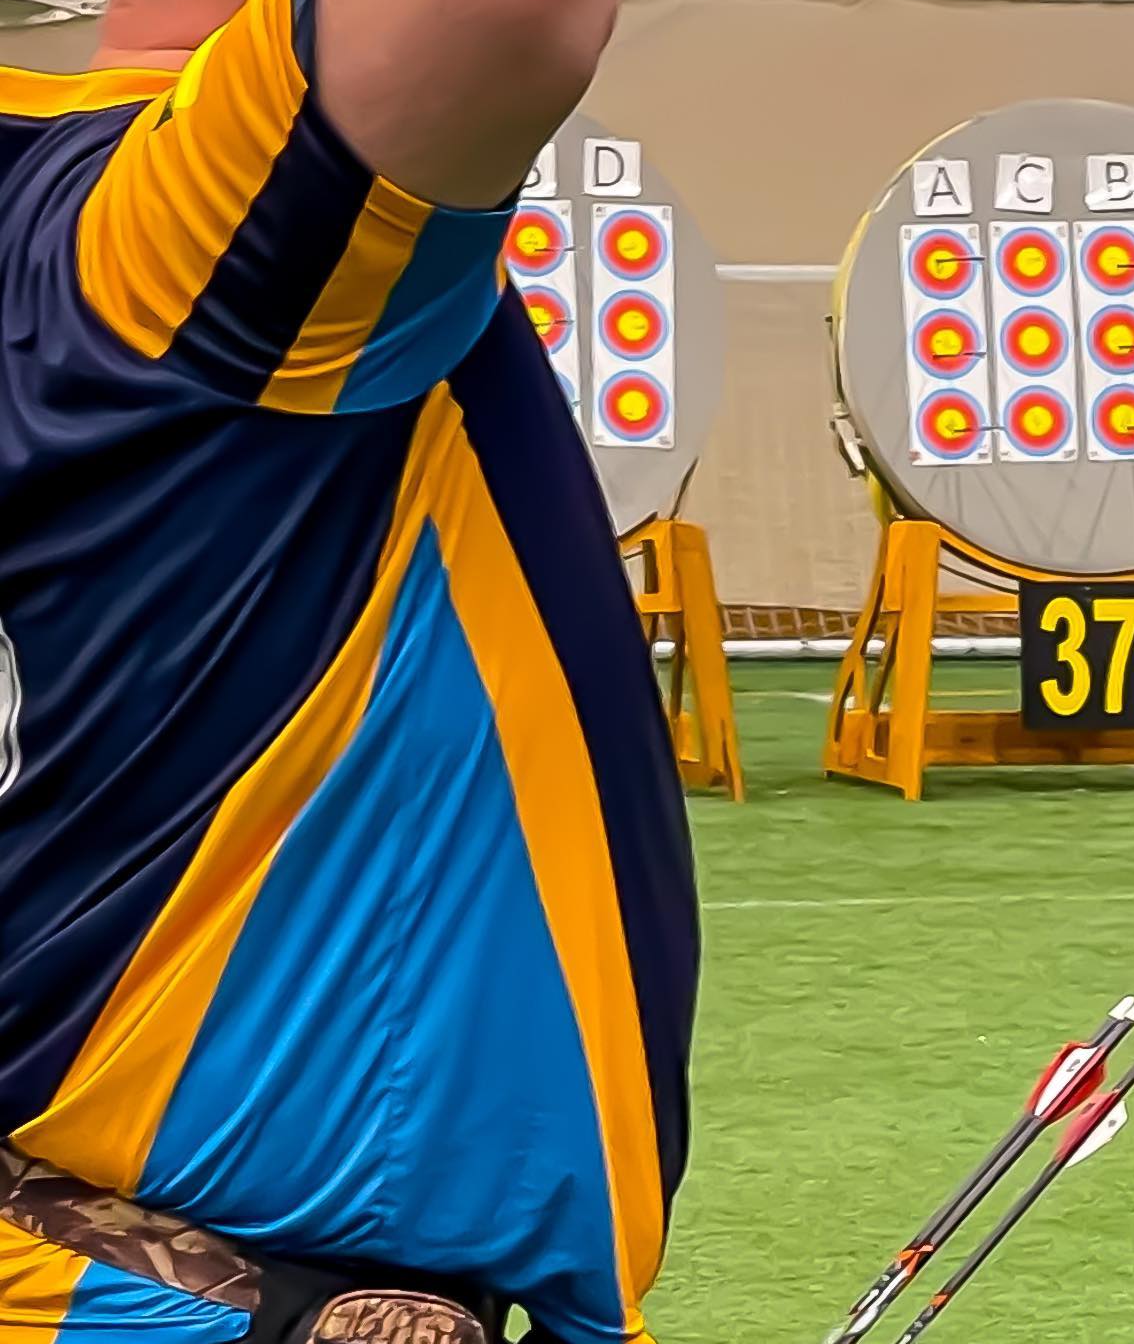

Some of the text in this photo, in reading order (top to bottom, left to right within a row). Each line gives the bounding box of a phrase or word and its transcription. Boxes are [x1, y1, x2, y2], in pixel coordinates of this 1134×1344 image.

[592, 146, 624, 187] D
[927, 166, 962, 207] A
[1014, 162, 1046, 204] C
